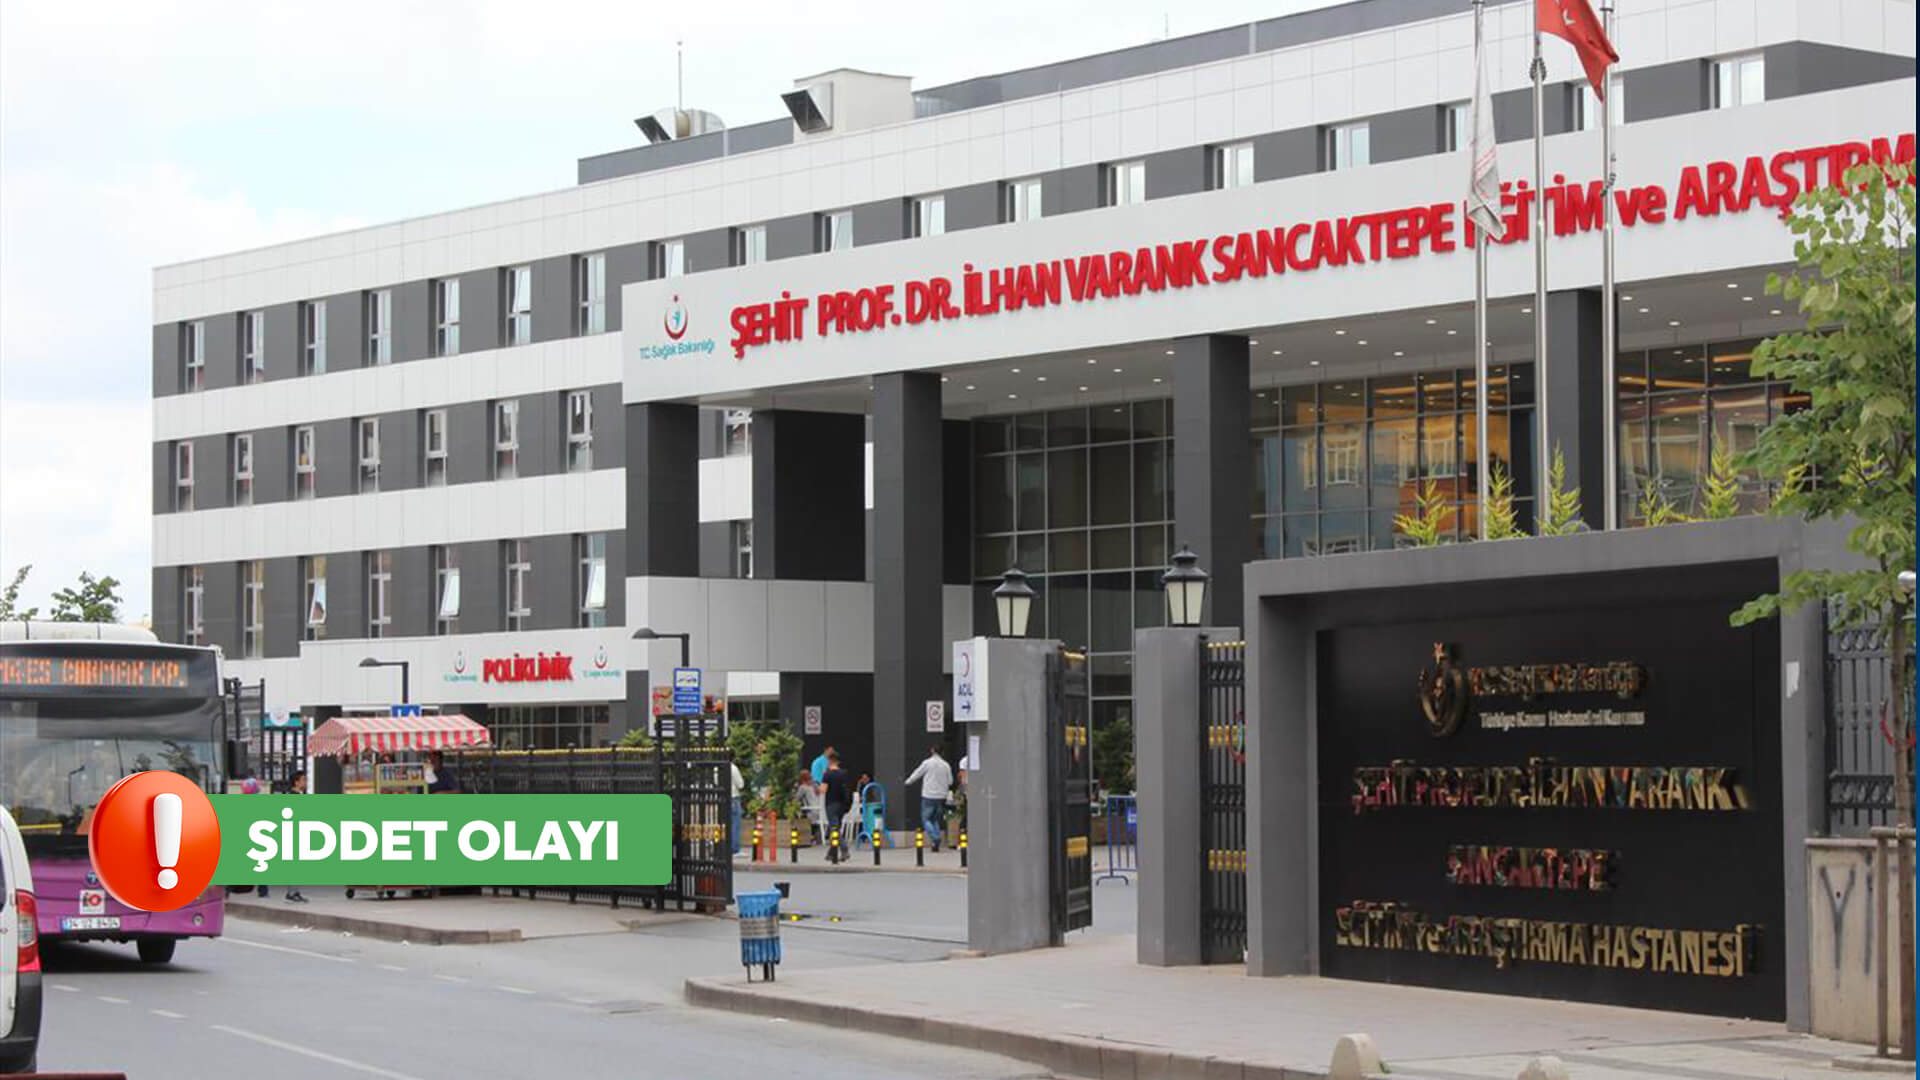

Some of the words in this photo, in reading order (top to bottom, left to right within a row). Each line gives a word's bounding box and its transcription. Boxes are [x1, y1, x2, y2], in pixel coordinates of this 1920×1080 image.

[731, 291, 808, 359] ŞEHİT
[817, 285, 902, 336] PROF.
[906, 278, 961, 325] DR.
[964, 263, 1061, 316] İLHAN
[1064, 239, 1209, 302] VARANK
[1212, 202, 1456, 284] SANCAKTEPE
[1615, 185, 1667, 227] ve
[483, 652, 573, 683] POLİKLİNİK
[1593, 923, 1745, 977] HASTANESİ
